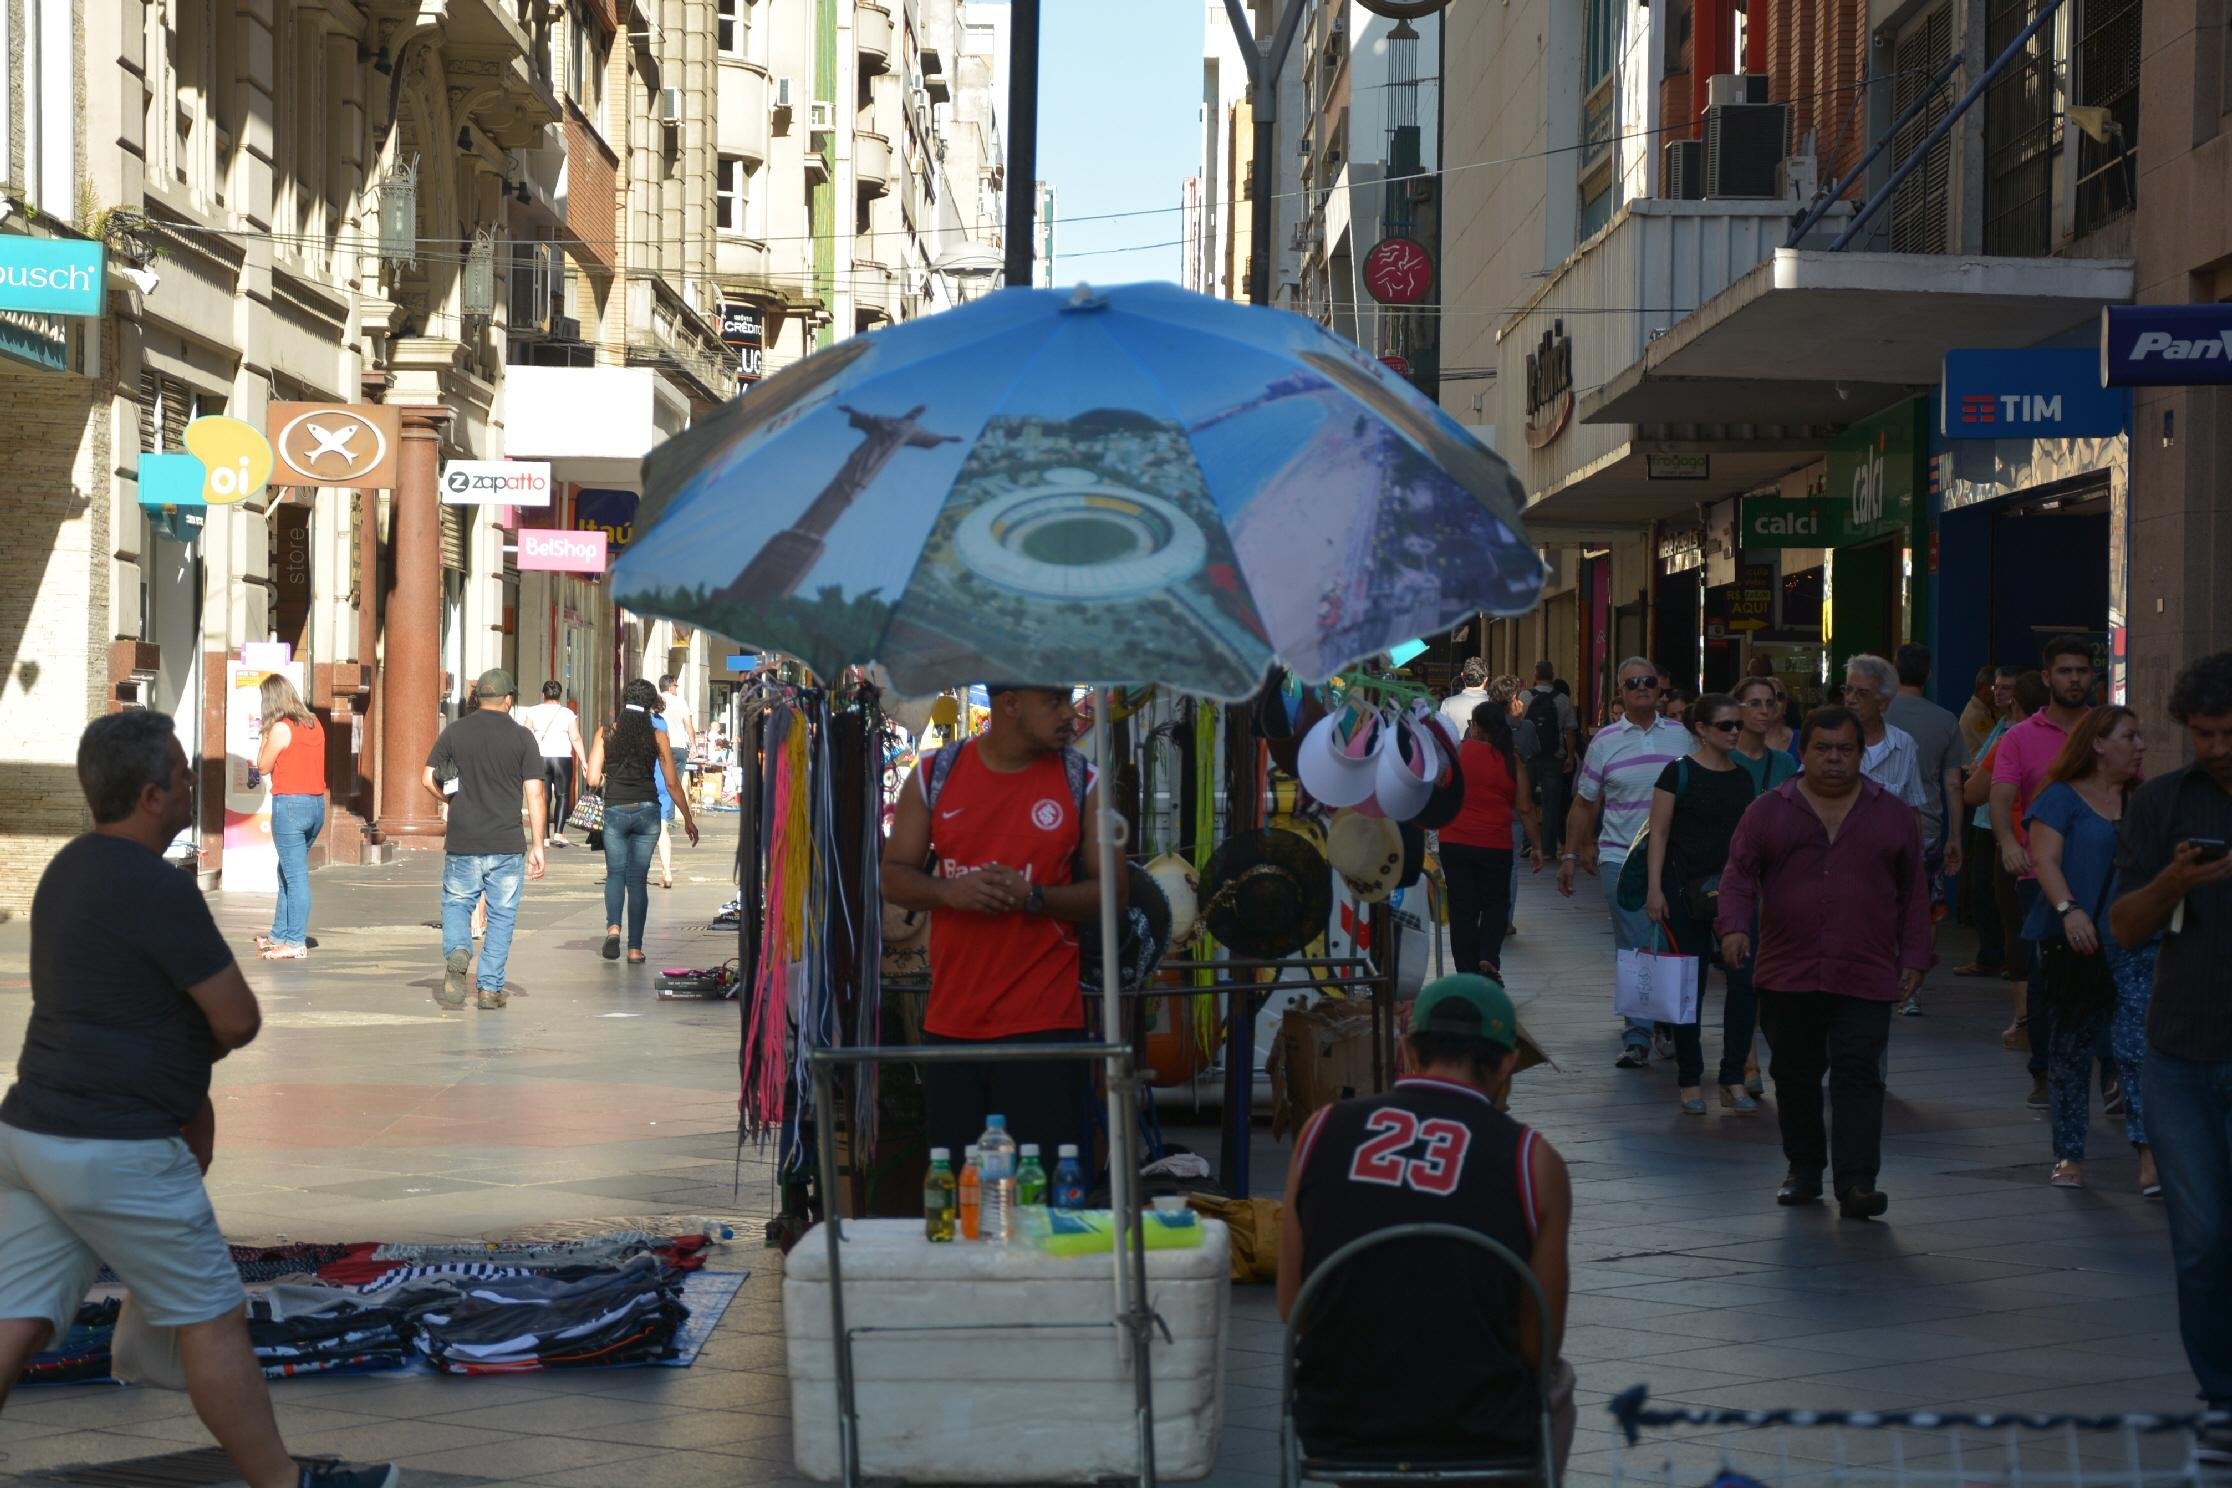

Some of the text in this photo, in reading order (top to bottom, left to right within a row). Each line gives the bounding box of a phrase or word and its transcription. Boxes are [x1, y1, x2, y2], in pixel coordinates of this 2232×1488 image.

[737, 348, 762, 374] UG
[2001, 395, 2062, 422] TIM
[211, 456, 249, 495] oi
[472, 473, 545, 493] zapatto
[1853, 431, 1886, 526] calci
[1755, 507, 1819, 535] calci
[286, 527, 305, 584] store
[525, 537, 597, 563] BelShop
[1731, 601, 1768, 615] AQUI
[1349, 1107, 1472, 1195] 23
